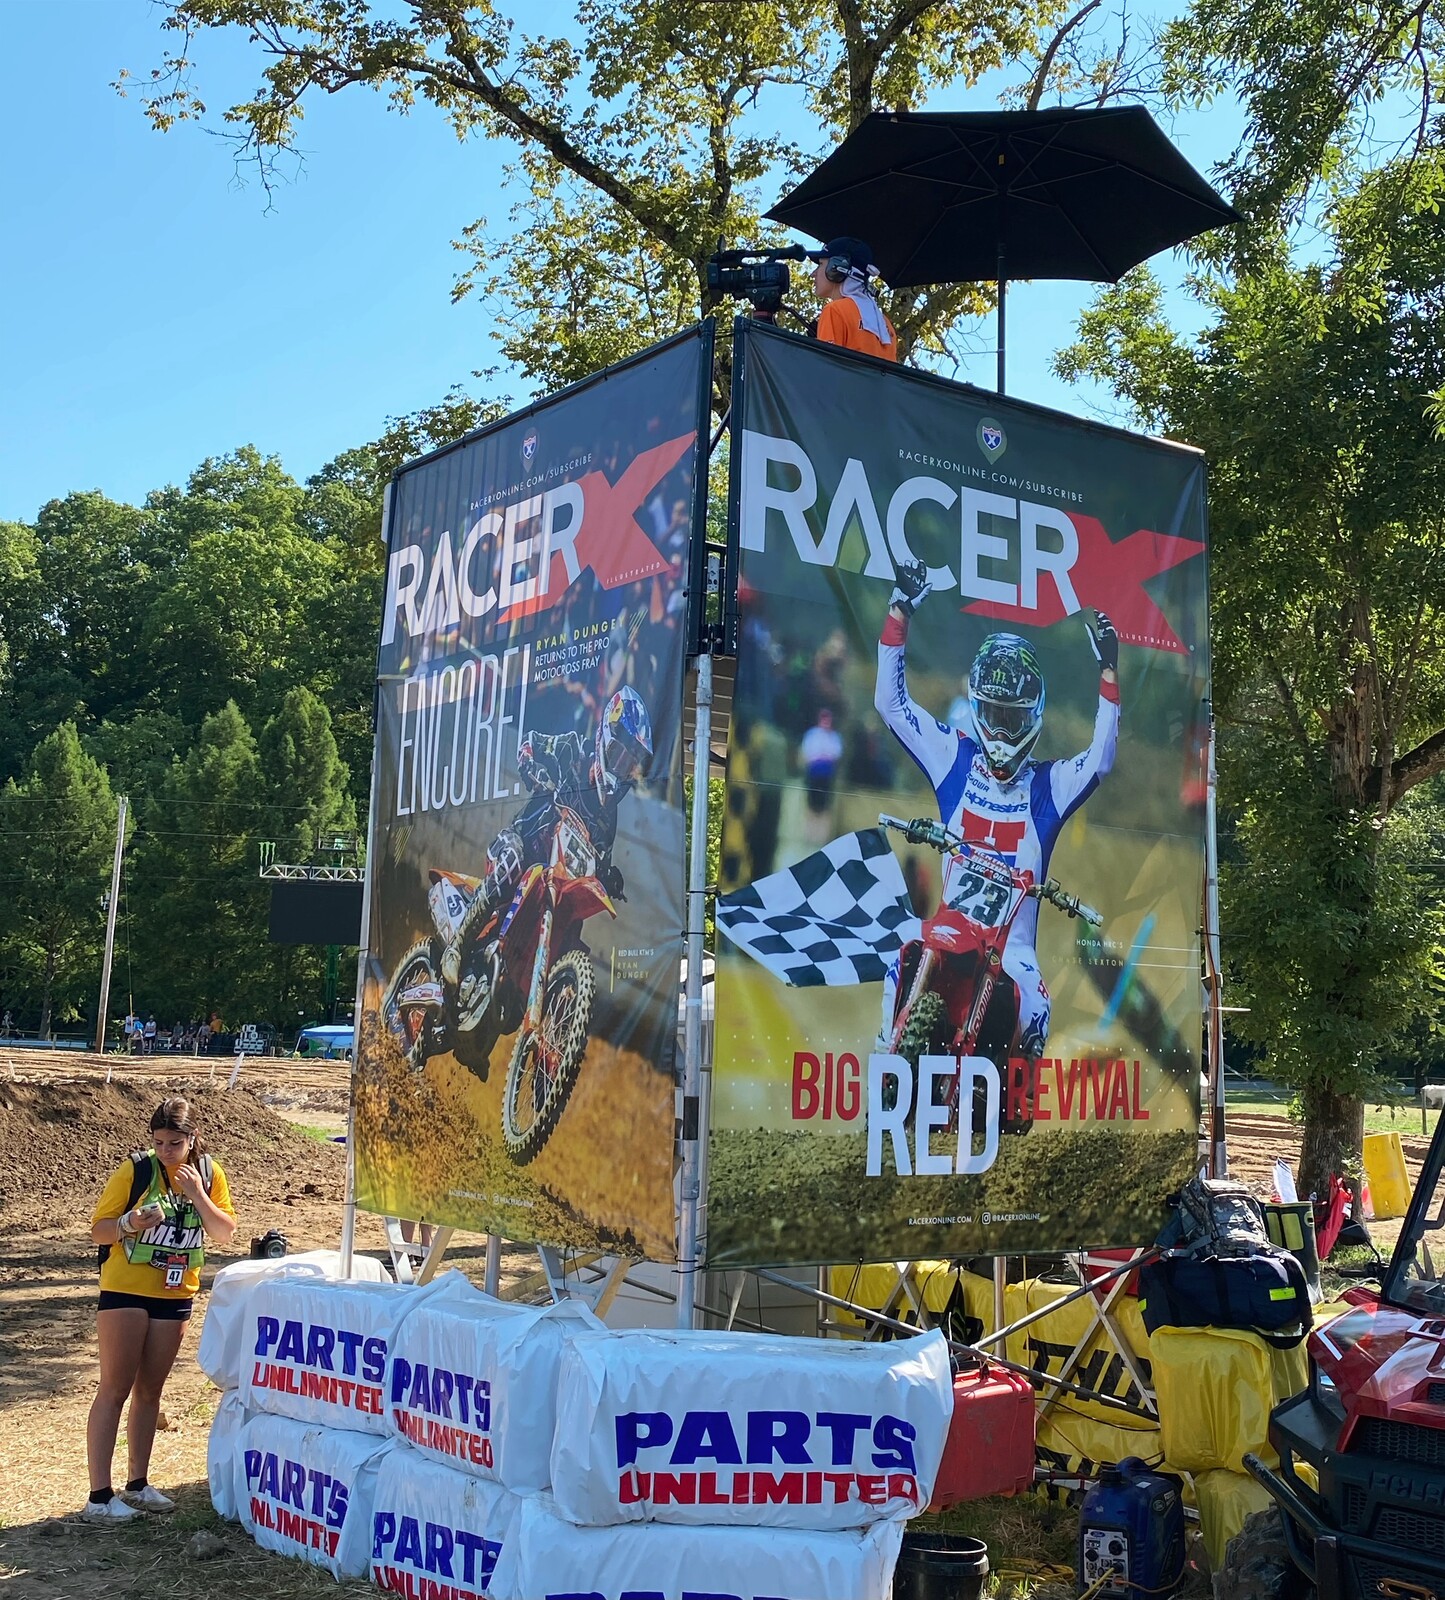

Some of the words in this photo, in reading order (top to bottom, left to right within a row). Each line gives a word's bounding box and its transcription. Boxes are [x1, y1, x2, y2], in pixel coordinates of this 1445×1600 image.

[470, 453, 592, 511] RACERXONLINE.COM/SUBSCRIBE
[899, 449, 1083, 503] RACERXONLINE.COM/SUBSCRIBE
[534, 660, 580, 683] MOTOCROSS
[581, 655, 601, 671] FRAY
[535, 649, 566, 667] RETURNS
[567, 646, 578, 658] TO
[579, 641, 593, 655] THE
[594, 636, 610, 651] PRO
[536, 633, 567, 651] RYAN
[396, 643, 531, 817] ENCORE!
[947, 872, 1009, 927] 23
[1076, 939, 1101, 947] HONDA
[1088, 958, 1124, 967] SEXTON
[616, 971, 649, 979] DUNGEY
[792, 1051, 861, 1121] BIG
[865, 1053, 1001, 1177] RED
[1007, 1057, 1149, 1121] REVIVAL
[141, 1224, 202, 1249] MEDIA
[169, 1271, 180, 1282] 47
[254, 1316, 388, 1383] PARTS
[391, 1358, 491, 1432] PARTS
[392, 1408, 494, 1468] UNLIMITED
[615, 1411, 917, 1475] PARTS
[244, 1450, 349, 1530] PARTS
[618, 1471, 919, 1507] UNLIMITED
